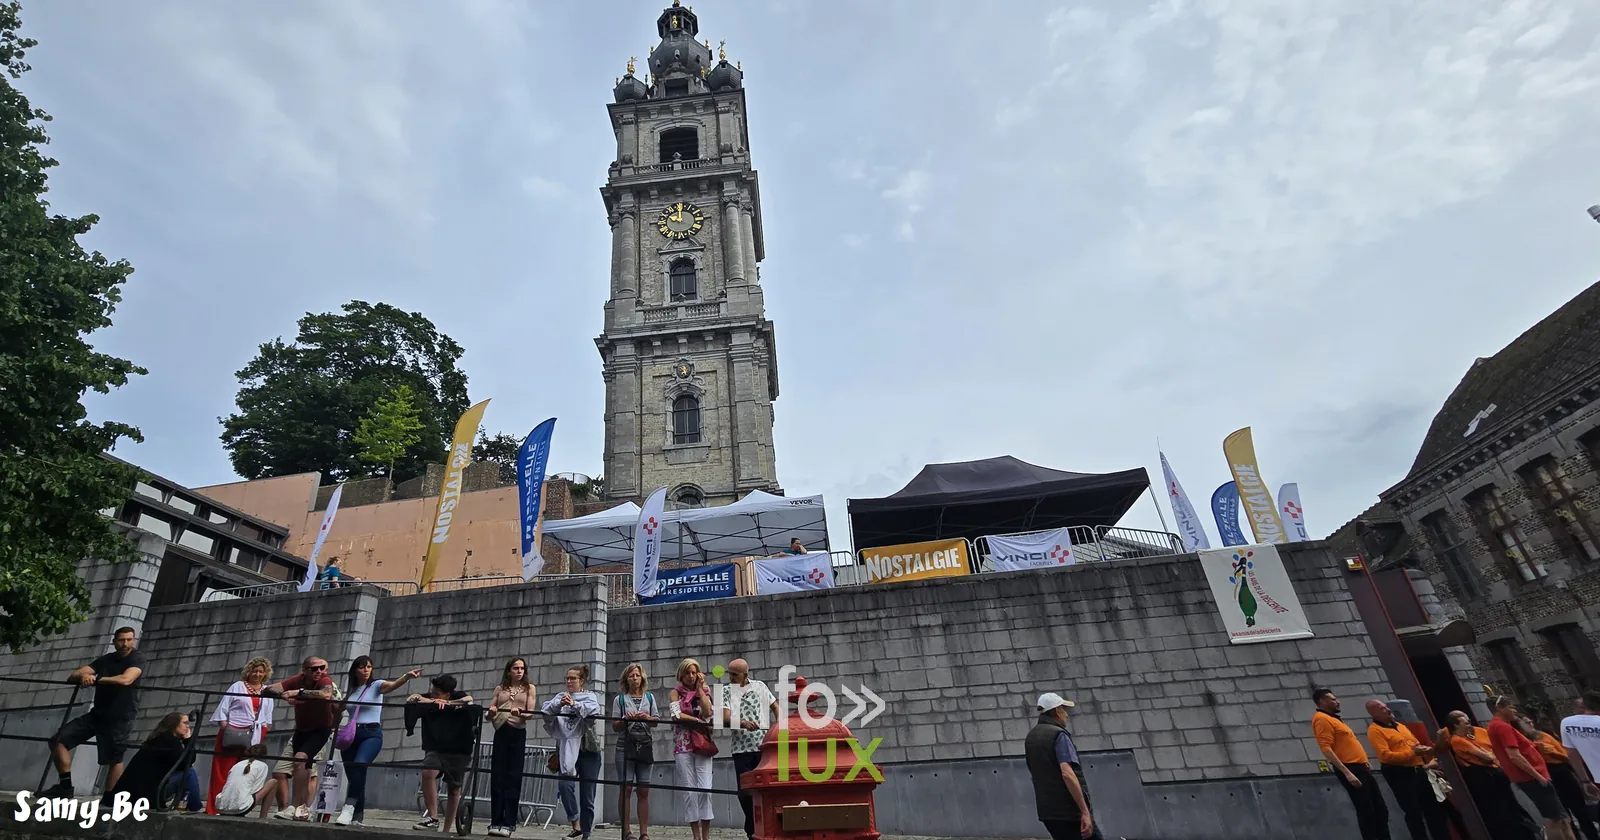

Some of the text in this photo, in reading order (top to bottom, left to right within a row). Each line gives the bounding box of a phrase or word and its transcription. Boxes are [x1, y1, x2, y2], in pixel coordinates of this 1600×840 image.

[642, 538, 653, 585] VINCI
[996, 552, 1048, 562] VINCI
[866, 547, 962, 581] NOSTALGIE
[667, 572, 729, 586] DELZELLE
[767, 574, 806, 584] VINCI
[1565, 725, 1600, 734] STUDI
